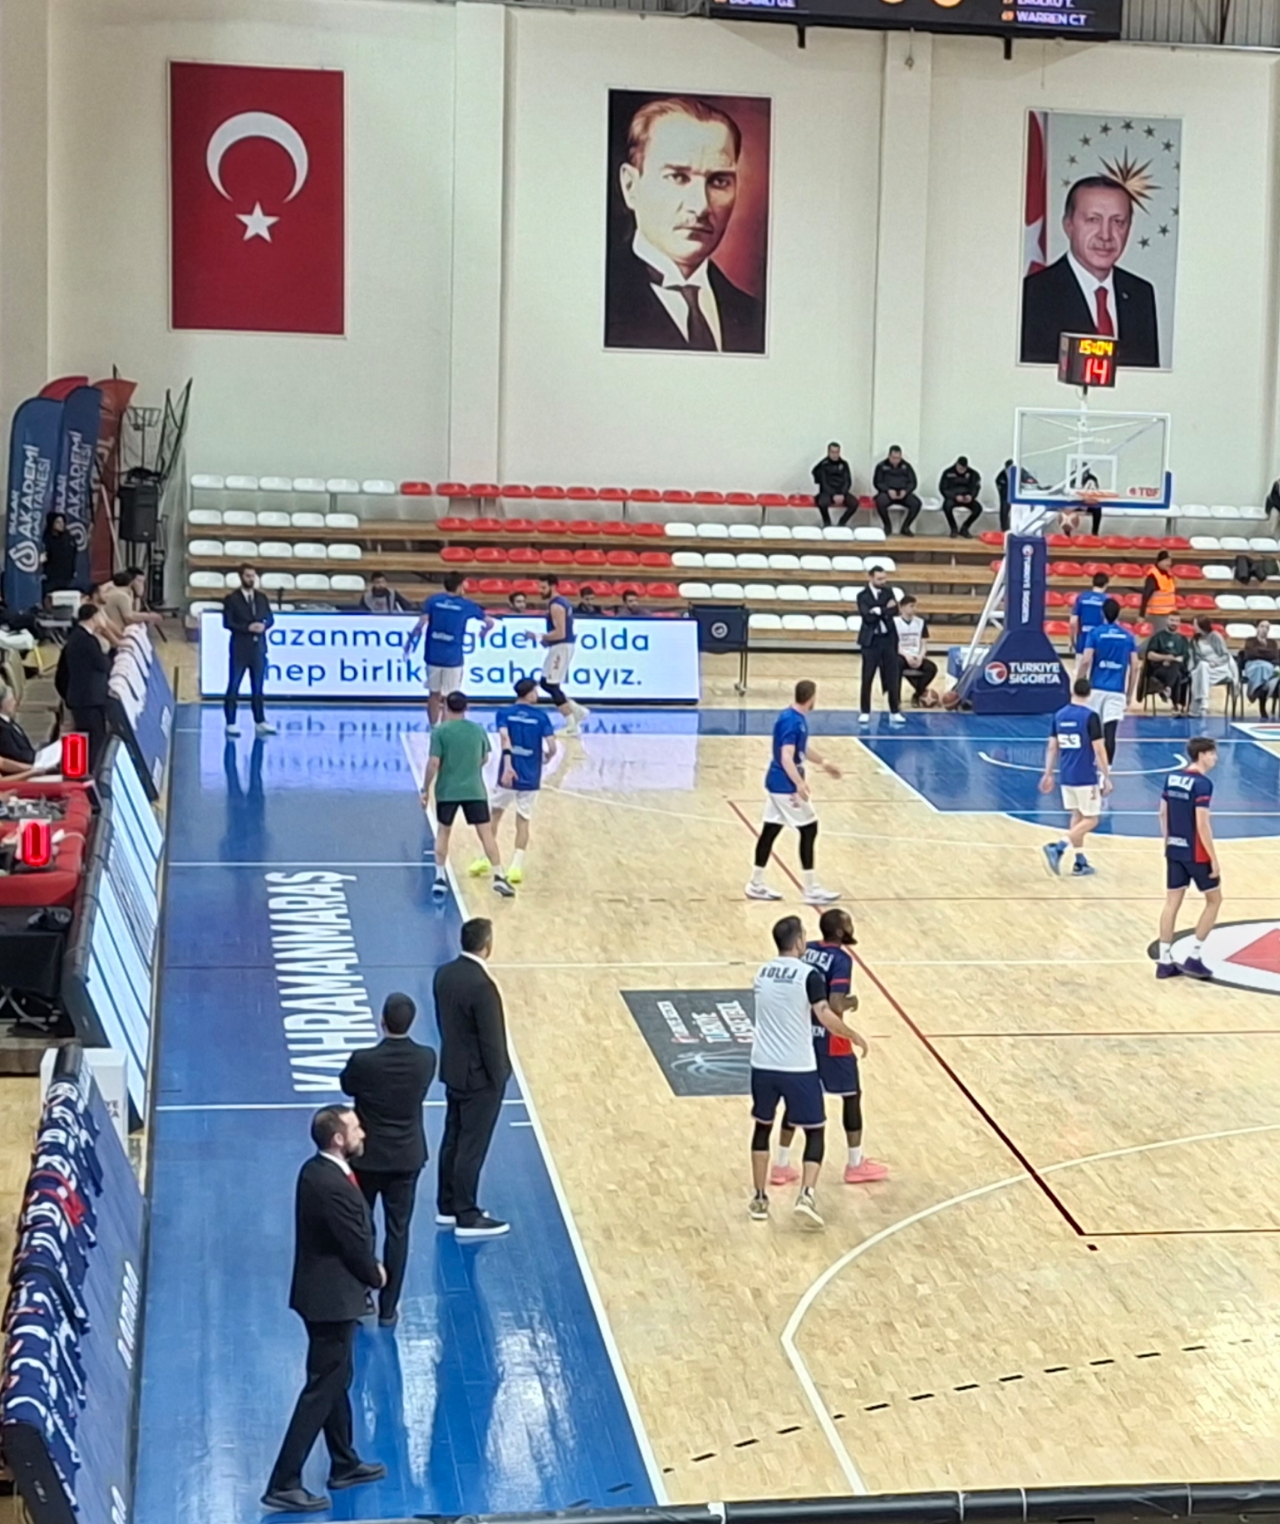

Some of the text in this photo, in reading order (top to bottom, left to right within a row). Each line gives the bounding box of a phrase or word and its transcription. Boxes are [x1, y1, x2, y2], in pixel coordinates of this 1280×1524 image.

[1016, 10, 1068, 25] WARREN
[1079, 339, 1114, 356] 15:04
[1084, 358, 1109, 385] 14
[68, 430, 83, 519] AKADEMİ
[18, 444, 39, 538] AKADEMİ
[579, 627, 649, 650] olda
[340, 658, 423, 683] birlik
[264, 871, 378, 1091] KAHRAMANMARAŞ
